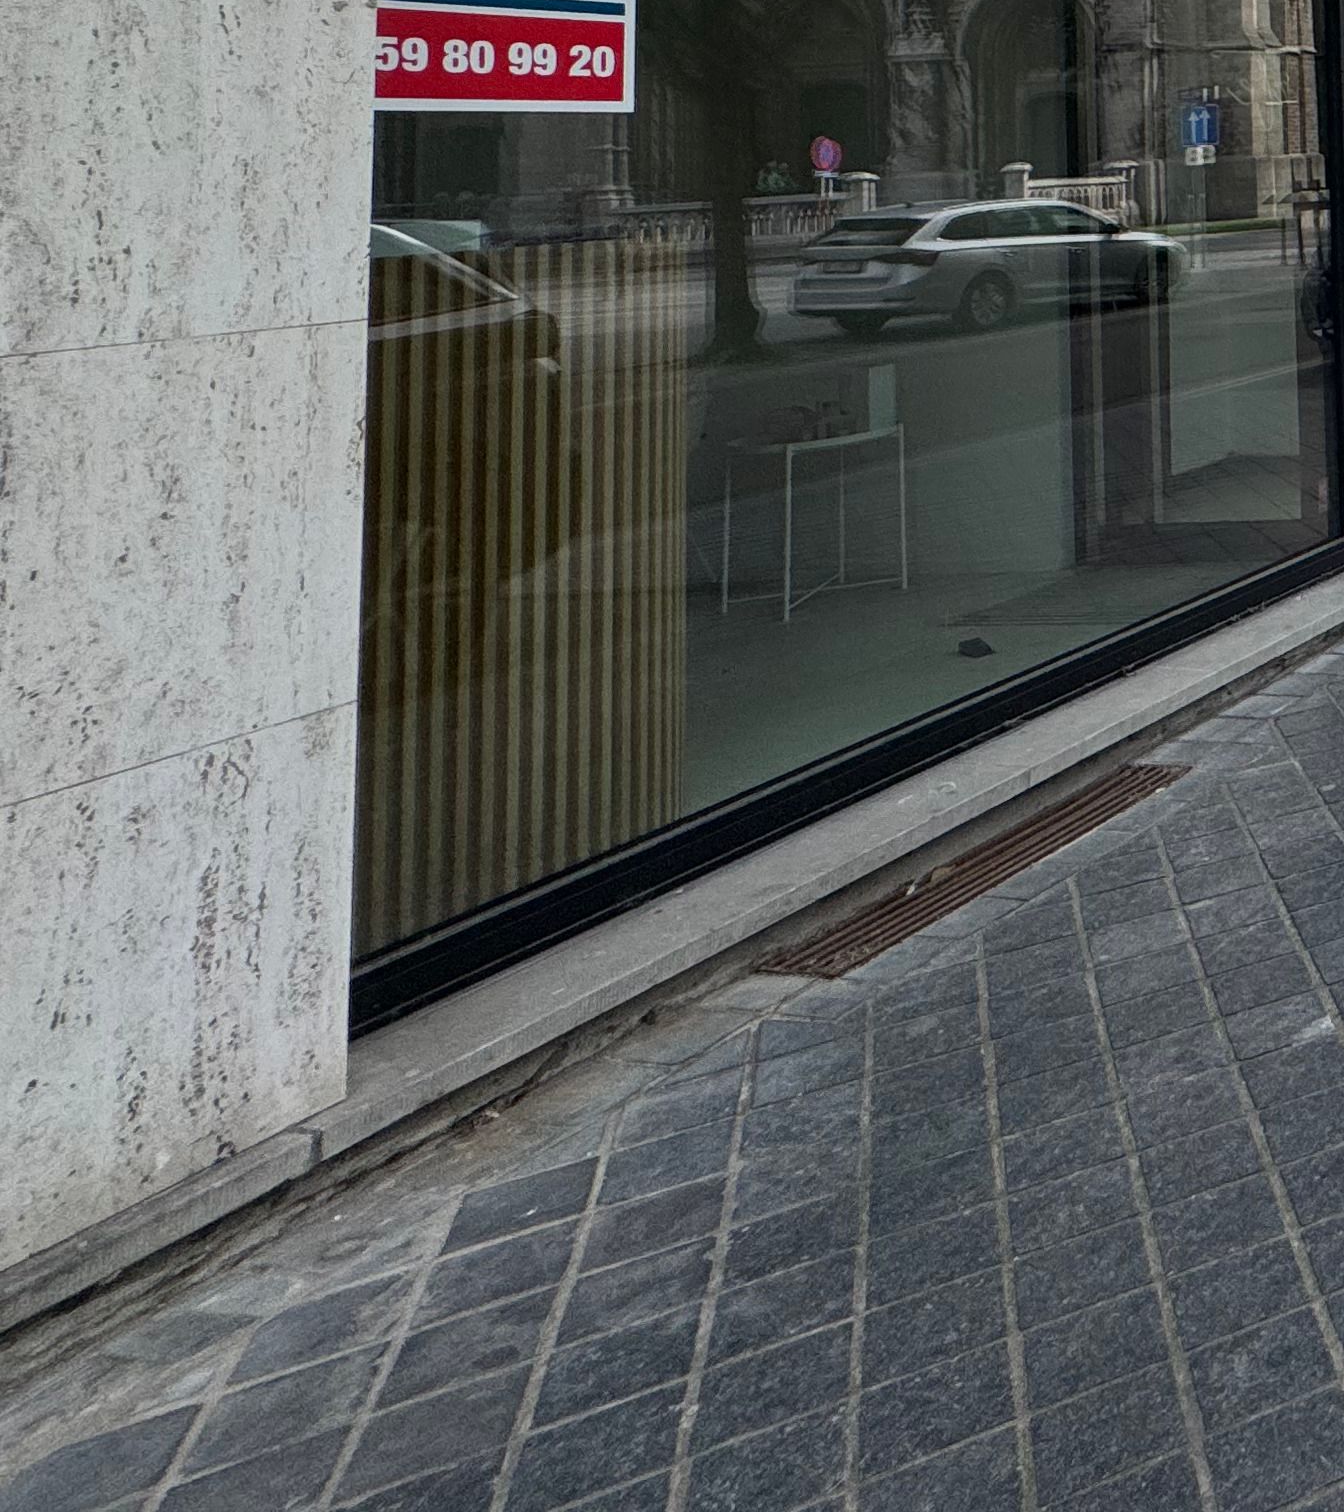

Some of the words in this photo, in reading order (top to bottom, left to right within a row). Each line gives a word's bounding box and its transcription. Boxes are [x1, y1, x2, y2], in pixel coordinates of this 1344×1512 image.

[375, 36, 429, 72] 59
[442, 39, 495, 74] 80
[508, 41, 557, 76] 99
[568, 44, 616, 78] 20
